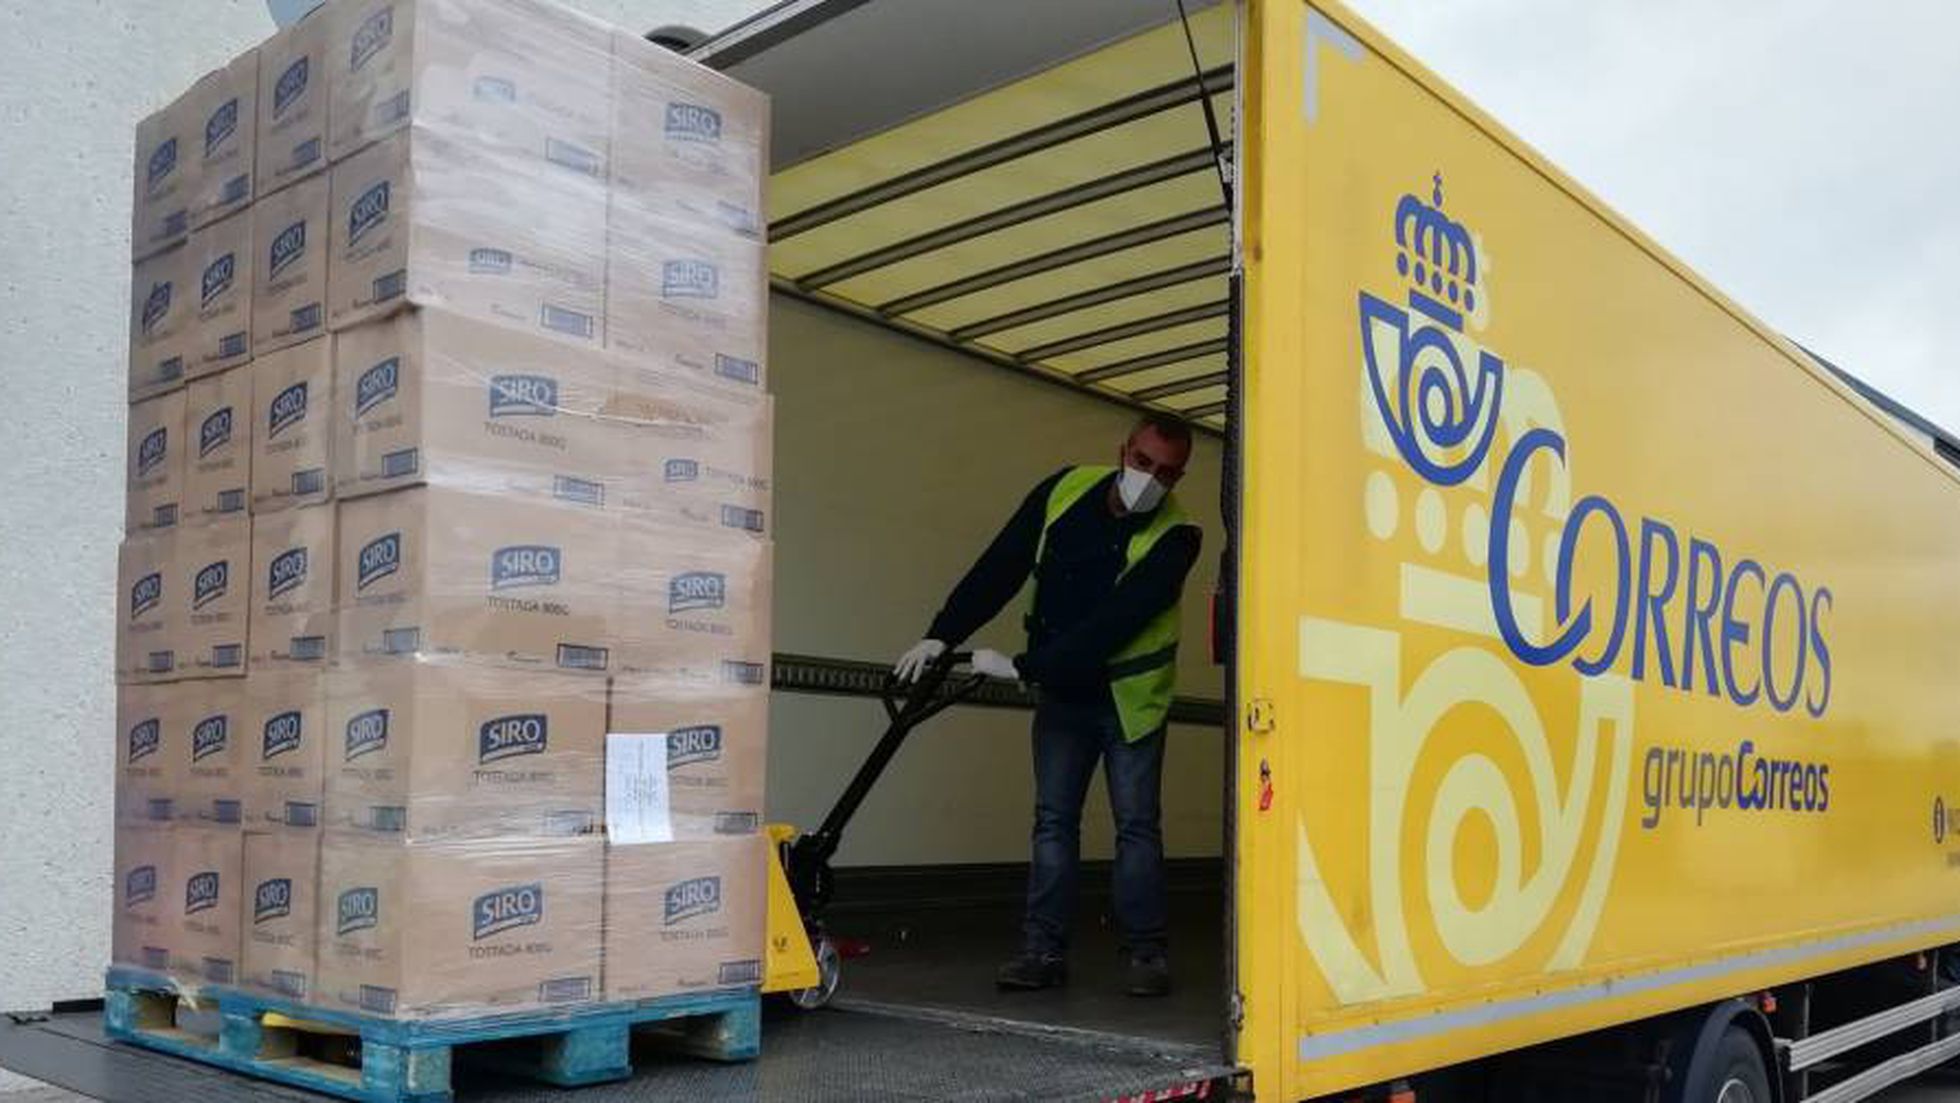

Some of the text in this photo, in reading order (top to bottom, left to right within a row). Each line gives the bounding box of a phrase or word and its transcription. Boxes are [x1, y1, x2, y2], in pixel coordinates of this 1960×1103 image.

[671, 105, 716, 133] SIRO
[272, 226, 303, 261] SIRO
[361, 363, 397, 398] SIRO
[500, 378, 552, 404] SIRO
[273, 387, 305, 418] SIRO
[272, 551, 305, 584] SIRO
[361, 538, 396, 575] SIRO
[502, 551, 554, 576] SIRO
[198, 566, 226, 594] SIRO
[674, 577, 720, 598] SIRO
[1488, 428, 1833, 718] CORREOS
[196, 719, 223, 748] SIRO
[269, 715, 299, 743] SIRO
[349, 713, 385, 744] SIRO
[488, 719, 540, 749] SIRO
[672, 729, 715, 757] SIRO
[191, 876, 216, 902] SIRO
[260, 882, 289, 909] SIRO
[671, 880, 715, 913] SIRO
[341, 891, 376, 919] SIRO
[482, 889, 535, 925] SIRO
